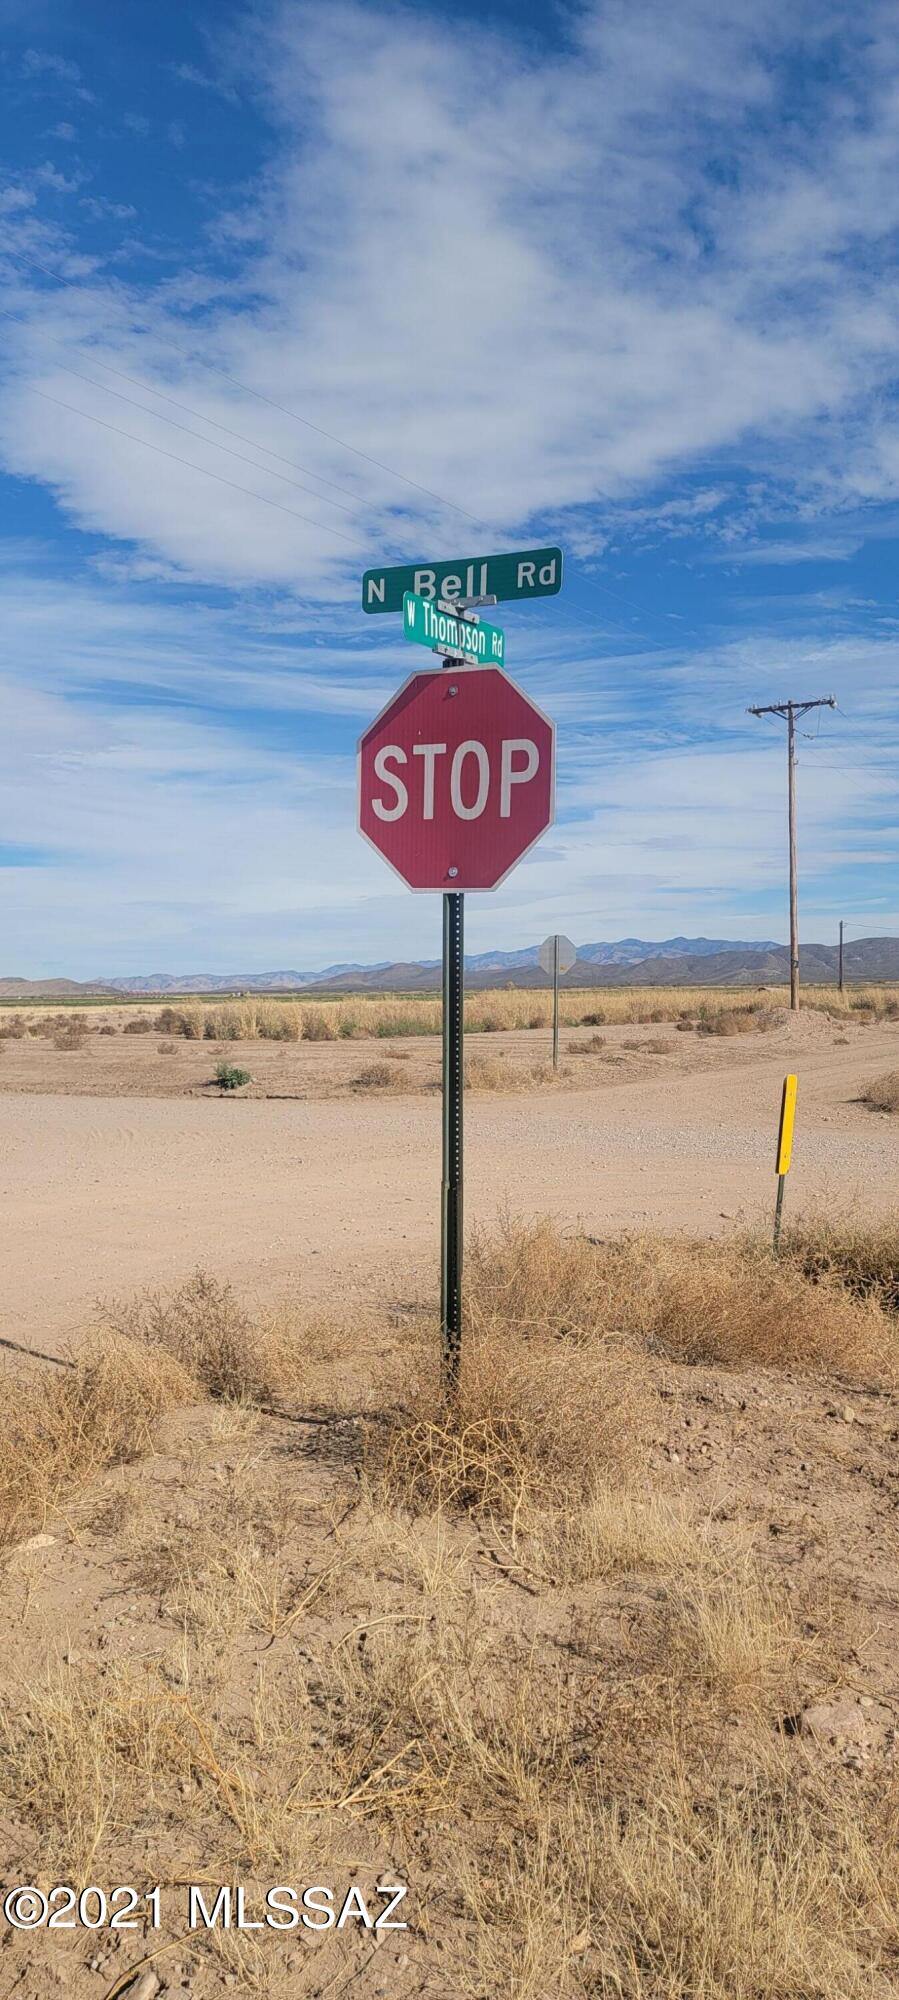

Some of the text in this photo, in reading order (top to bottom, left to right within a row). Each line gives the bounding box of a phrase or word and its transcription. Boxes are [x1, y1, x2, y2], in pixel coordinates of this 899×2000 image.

[367, 558, 556, 603] N Bell Rd
[407, 599, 503, 658] W Thompson Rd
[371, 738, 540, 822] STOP
